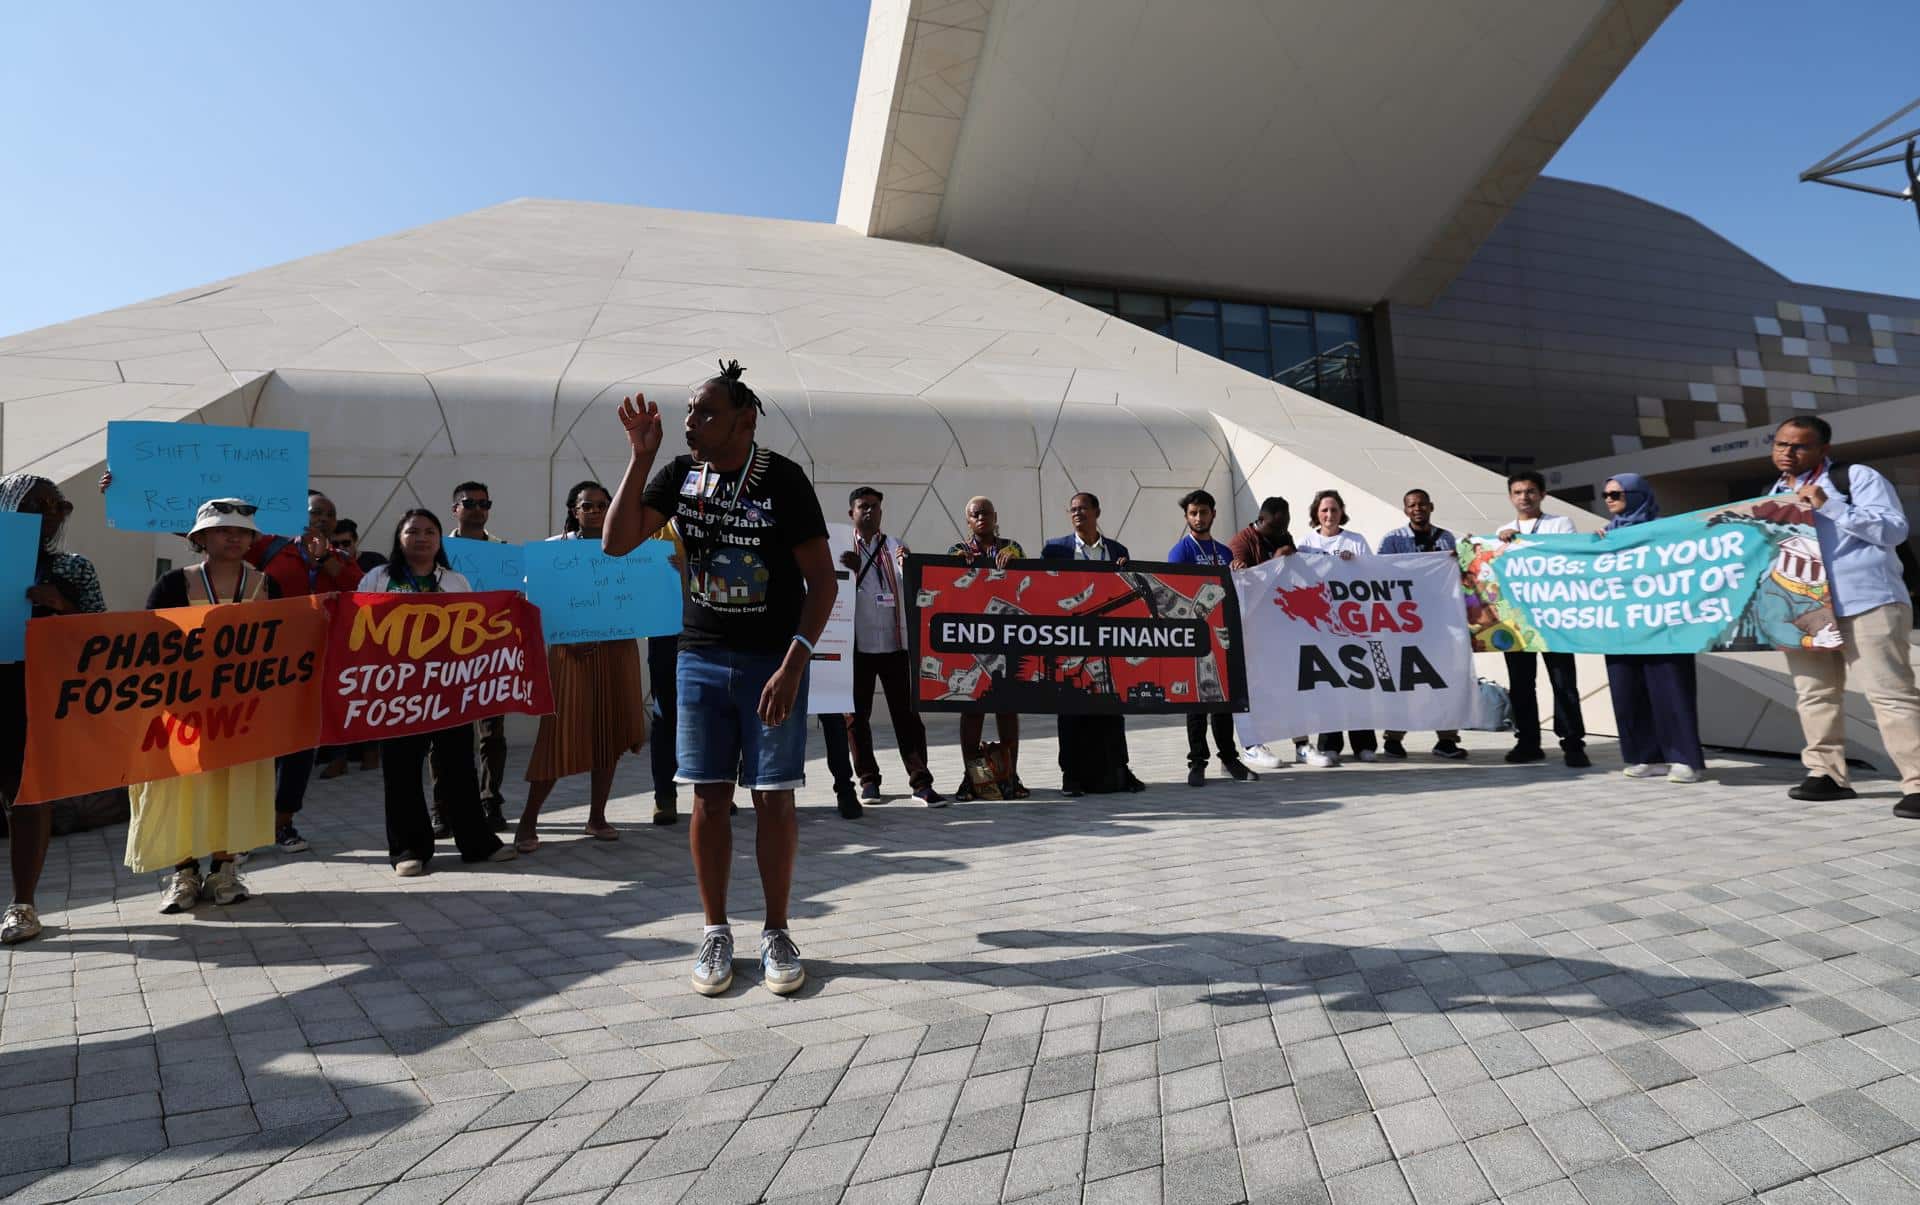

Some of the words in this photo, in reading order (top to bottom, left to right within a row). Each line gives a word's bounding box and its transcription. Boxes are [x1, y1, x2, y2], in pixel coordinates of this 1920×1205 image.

[135, 440, 200, 463] SHIFT
[217, 443, 289, 463] FINANCE
[200, 473, 222, 484] TO
[686, 523, 710, 538] Th
[719, 531, 761, 546] uture
[448, 553, 480, 573] AS
[553, 553, 578, 570] Get
[1504, 556, 1586, 578] MDBs:
[1593, 547, 1650, 572] GET
[1655, 531, 1745, 566] YOUR
[1328, 580, 1413, 601] DON'T
[1510, 578, 1626, 604] FINANCE
[1632, 569, 1695, 598] OUT
[1701, 563, 1746, 592] OF
[1338, 601, 1424, 633] GAS
[1531, 605, 1620, 630] FOSSIL
[1626, 597, 1734, 628] FUELS!
[77, 628, 205, 673] PHASE
[213, 619, 282, 658] OUT
[349, 602, 522, 660] MDBs,
[942, 622, 995, 644] END
[1003, 624, 1091, 646] FOSSIL
[1099, 627, 1196, 648] FINANCE
[338, 661, 416, 695] STOP
[1298, 640, 1449, 692] ASIA
[55, 669, 201, 719] FOSSIL
[210, 652, 315, 699] FUELS
[141, 698, 260, 752] NOW!
[343, 694, 450, 729] FOSSIL
